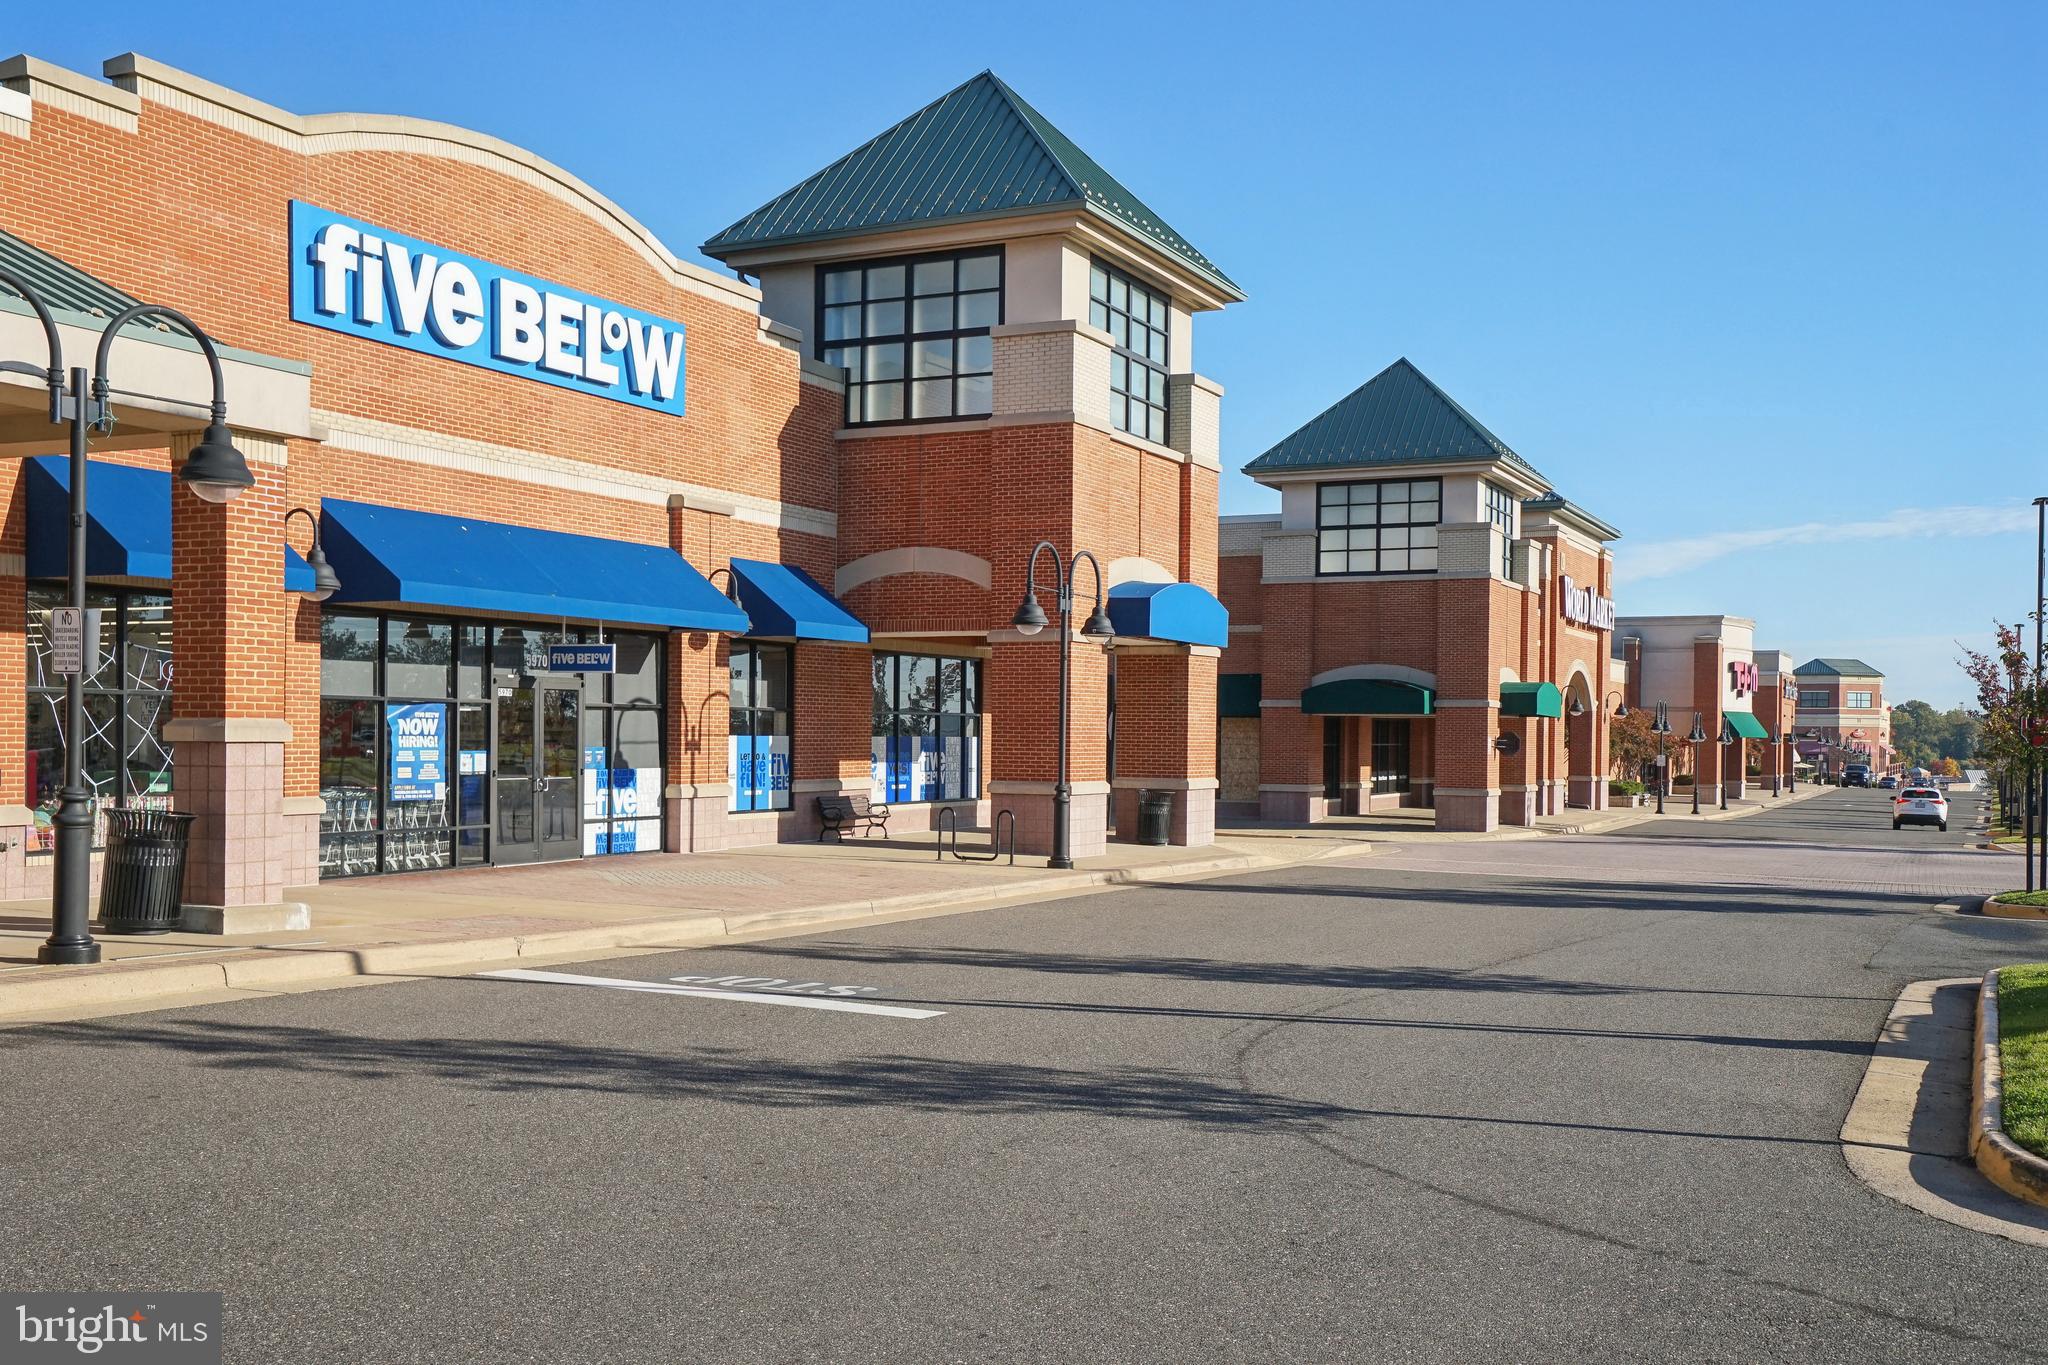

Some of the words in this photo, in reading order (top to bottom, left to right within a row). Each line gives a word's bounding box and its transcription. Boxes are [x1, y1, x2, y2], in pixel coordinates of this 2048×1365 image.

[308, 223, 484, 348] five
[1560, 575, 1589, 623] WORLD
[1587, 586, 1615, 630] MARKET
[61, 613, 72, 625] NO
[526, 654, 548, 667] 5970
[397, 718, 439, 735] NOW
[669, 975, 878, 996] STOP
